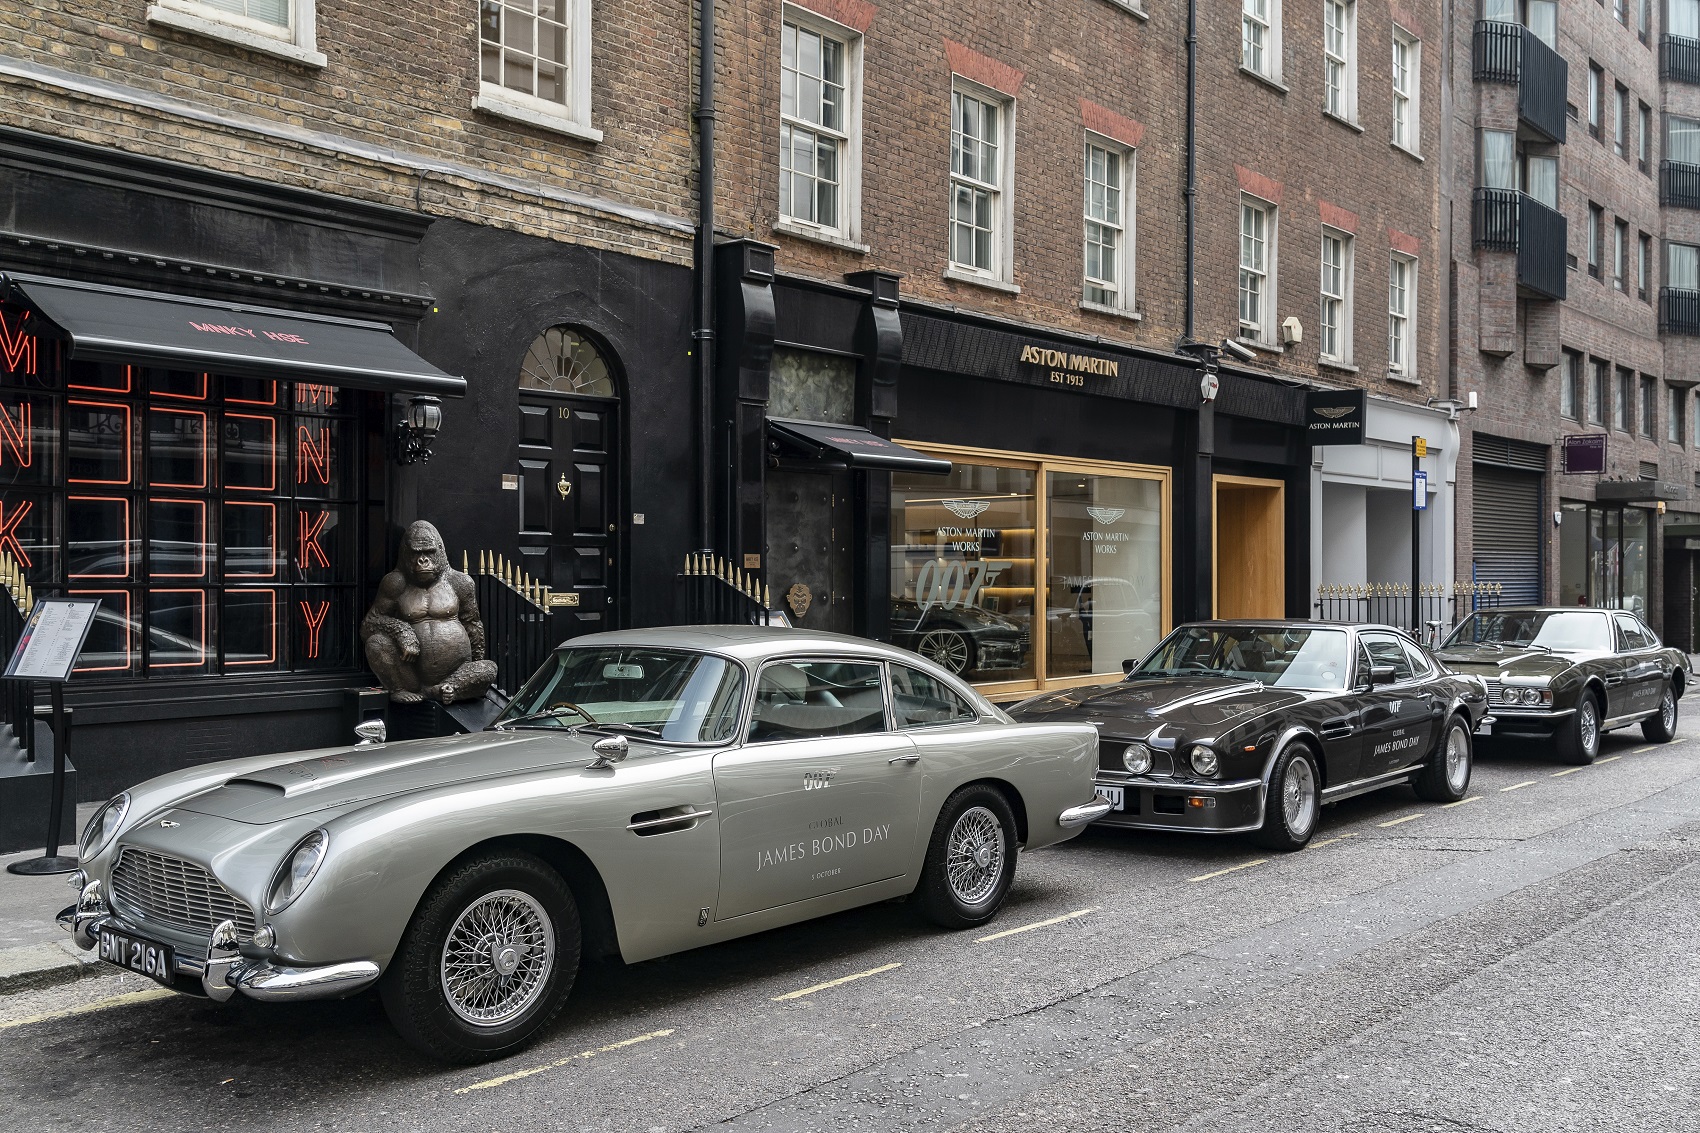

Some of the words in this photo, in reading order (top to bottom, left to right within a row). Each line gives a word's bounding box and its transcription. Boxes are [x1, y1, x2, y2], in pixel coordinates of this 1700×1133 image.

[188, 321, 256, 338] MNKY
[262, 330, 309, 345] HSE
[1020, 345, 1067, 369] ASTON
[1068, 353, 1118, 378] MARTIN
[1050, 371, 1065, 384] EST
[1065, 374, 1084, 387] 1913
[558, 406, 570, 419] 10
[1308, 422, 1331, 430] ASTON
[1332, 421, 1360, 429] MARTIN
[936, 526, 963, 537] ASTON
[965, 527, 996, 538] MARTIN
[1082, 531, 1103, 541] ASTON
[1104, 532, 1129, 542] MARTIN
[952, 541, 980, 552] WORKS
[1095, 544, 1117, 554] WORKS
[915, 559, 990, 611] 007
[1373, 742, 1391, 757] JAMES
[1392, 738, 1408, 751] BOND
[1409, 736, 1420, 748] DAY
[808, 816, 844, 830] GLOBAL
[756, 842, 805, 872] JAMES
[812, 831, 857, 856] BOND
[863, 823, 890, 844] DAY
[816, 867, 841, 880] OCTOBER
[101, 931, 129, 965] BMT
[130, 941, 167, 979] 216A
